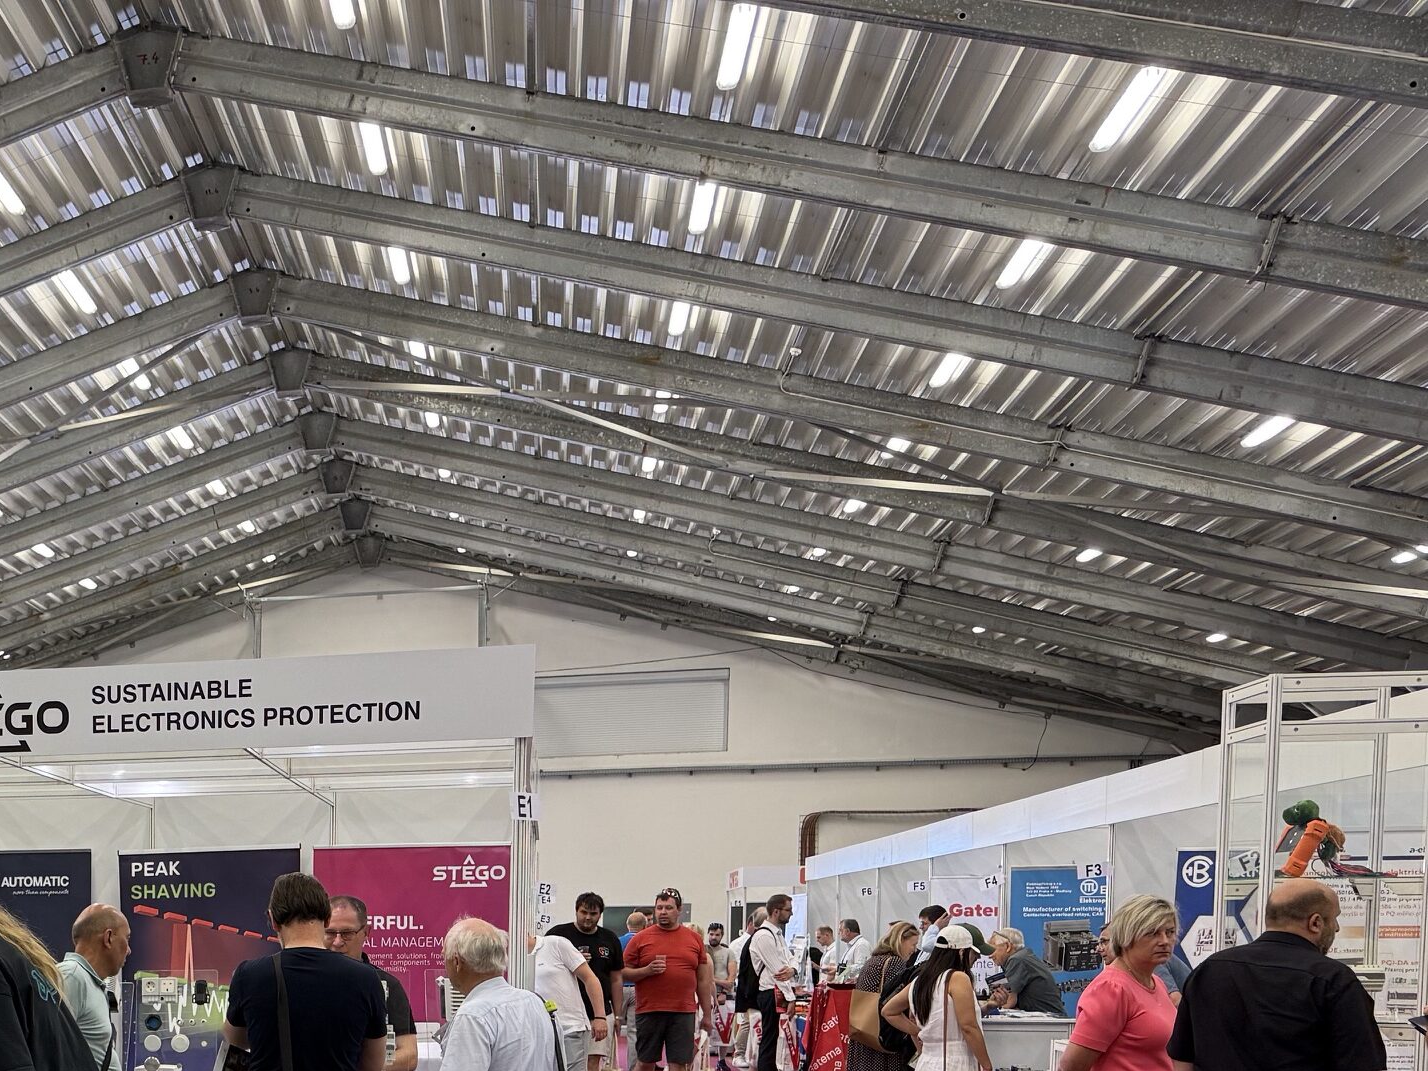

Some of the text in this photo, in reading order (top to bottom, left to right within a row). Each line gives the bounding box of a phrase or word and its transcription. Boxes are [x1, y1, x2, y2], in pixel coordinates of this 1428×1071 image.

[91, 678, 253, 705] SUSTAINABLE
[91, 701, 422, 734] ELECTRONICS PROTECTION
[517, 794, 533, 819] E1
[130, 861, 181, 877] PEAK
[1085, 863, 1103, 878] F3
[1, 875, 70, 888] AUTOMATIC
[913, 881, 926, 892] F5
[984, 875, 998, 889] F4
[130, 882, 217, 900] SHAVING
[539, 884, 551, 896] E2
[861, 886, 873, 897] F6
[542, 896, 551, 904] E4
[948, 903, 999, 917] Gate
[540, 914, 551, 924] E3
[396, 952, 427, 960] solutions
[389, 959, 431, 968] components
